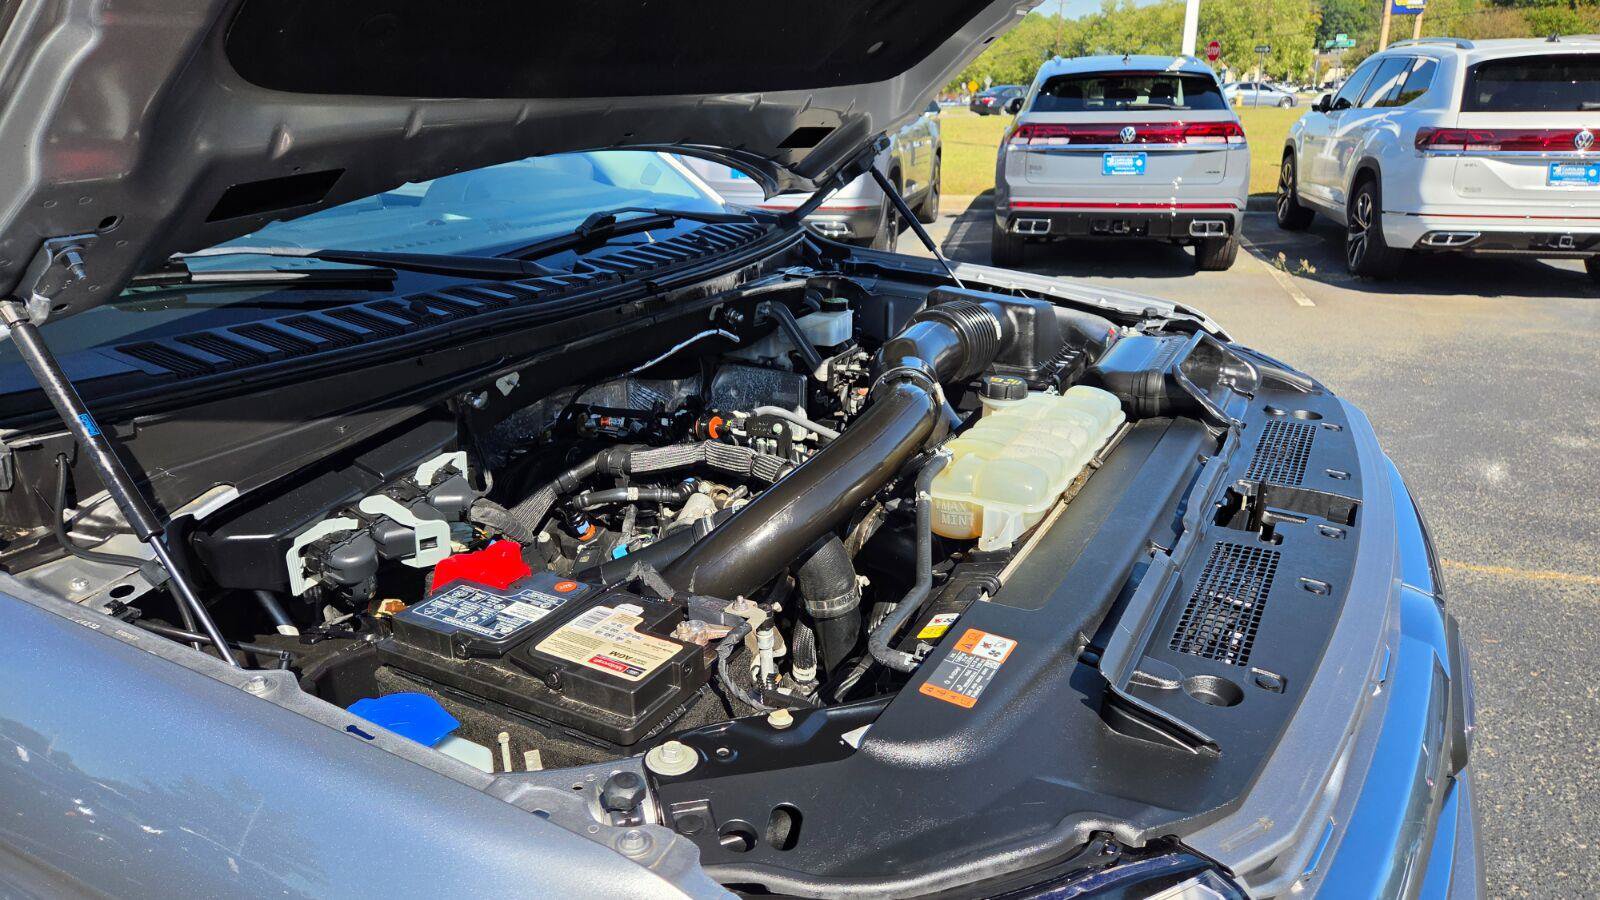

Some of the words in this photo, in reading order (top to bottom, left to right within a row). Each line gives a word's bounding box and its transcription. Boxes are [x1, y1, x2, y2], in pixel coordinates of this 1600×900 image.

[940, 502, 967, 513] MAX
[941, 514, 967, 528] MIN
[608, 650, 634, 661] AGM
